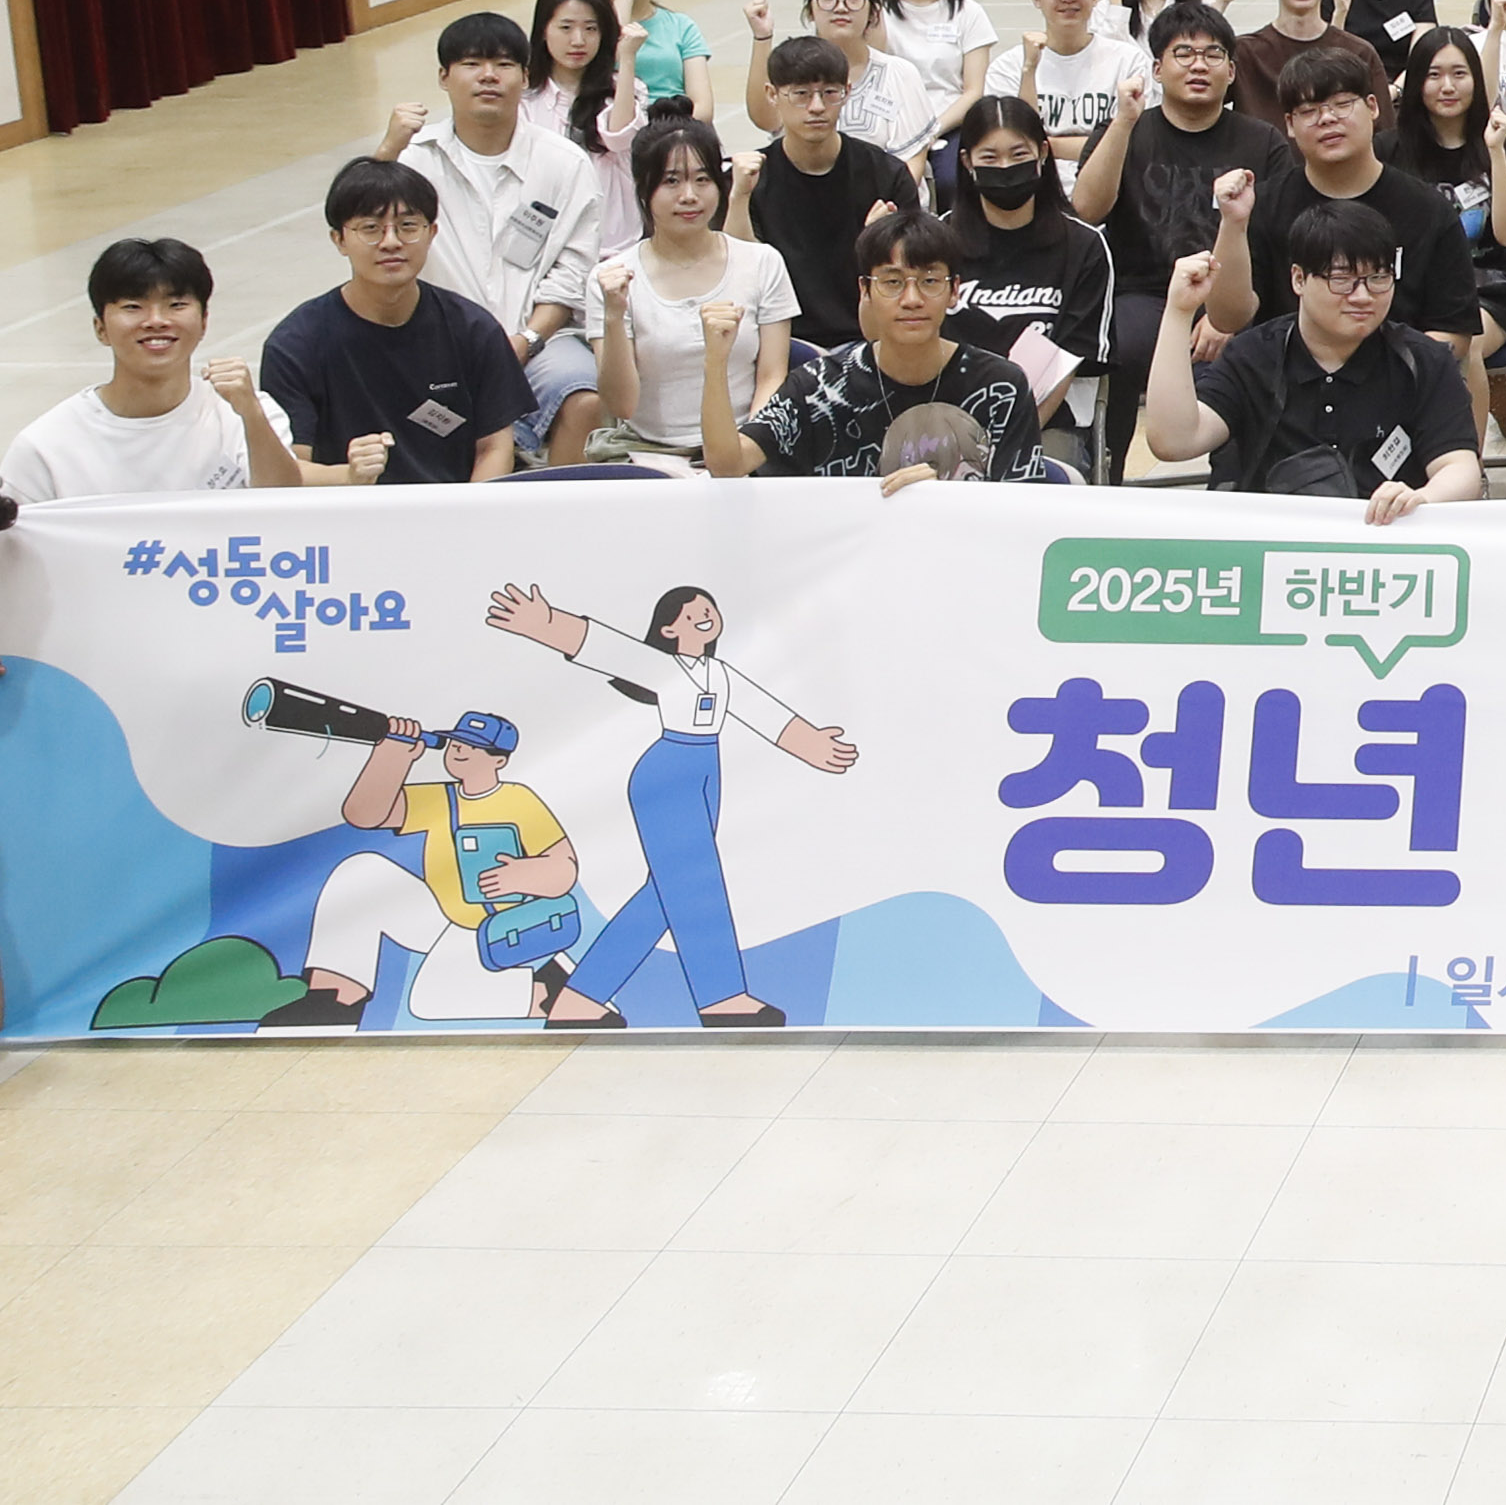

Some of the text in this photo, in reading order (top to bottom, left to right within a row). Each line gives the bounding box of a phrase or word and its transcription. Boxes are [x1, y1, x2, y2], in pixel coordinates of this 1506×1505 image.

[945, 279, 1063, 316] Indians
[123, 536, 330, 606] #성동에
[1066, 565, 1435, 618] 2025년 하반기
[256, 590, 411, 653] 살아요
[999, 677, 1467, 907] 청년
